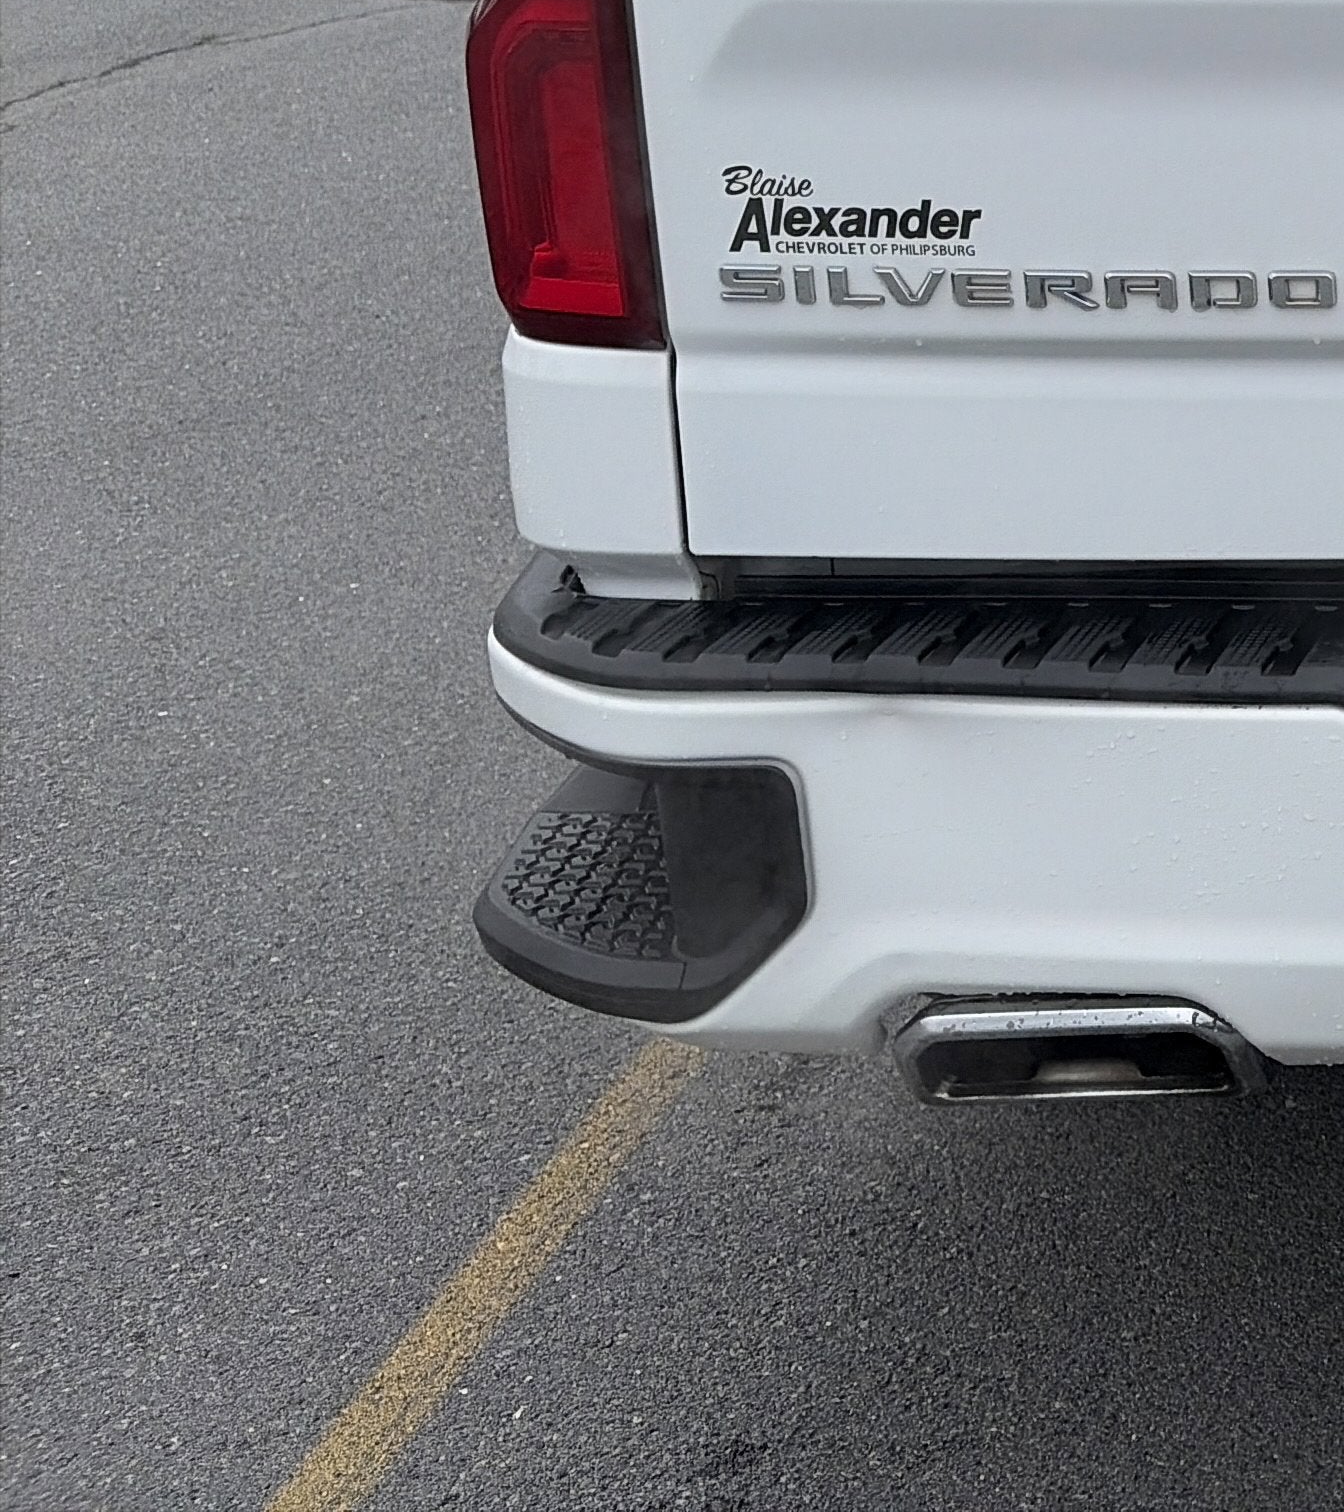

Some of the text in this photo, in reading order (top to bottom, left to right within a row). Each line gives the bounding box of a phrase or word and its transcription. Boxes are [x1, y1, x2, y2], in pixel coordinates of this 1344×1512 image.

[721, 165, 814, 197] Blaise
[729, 197, 982, 253] Alexander
[775, 240, 976, 257] CHEVROLET OF PHILIPSBURG
[718, 263, 1338, 312] SILVERADO
